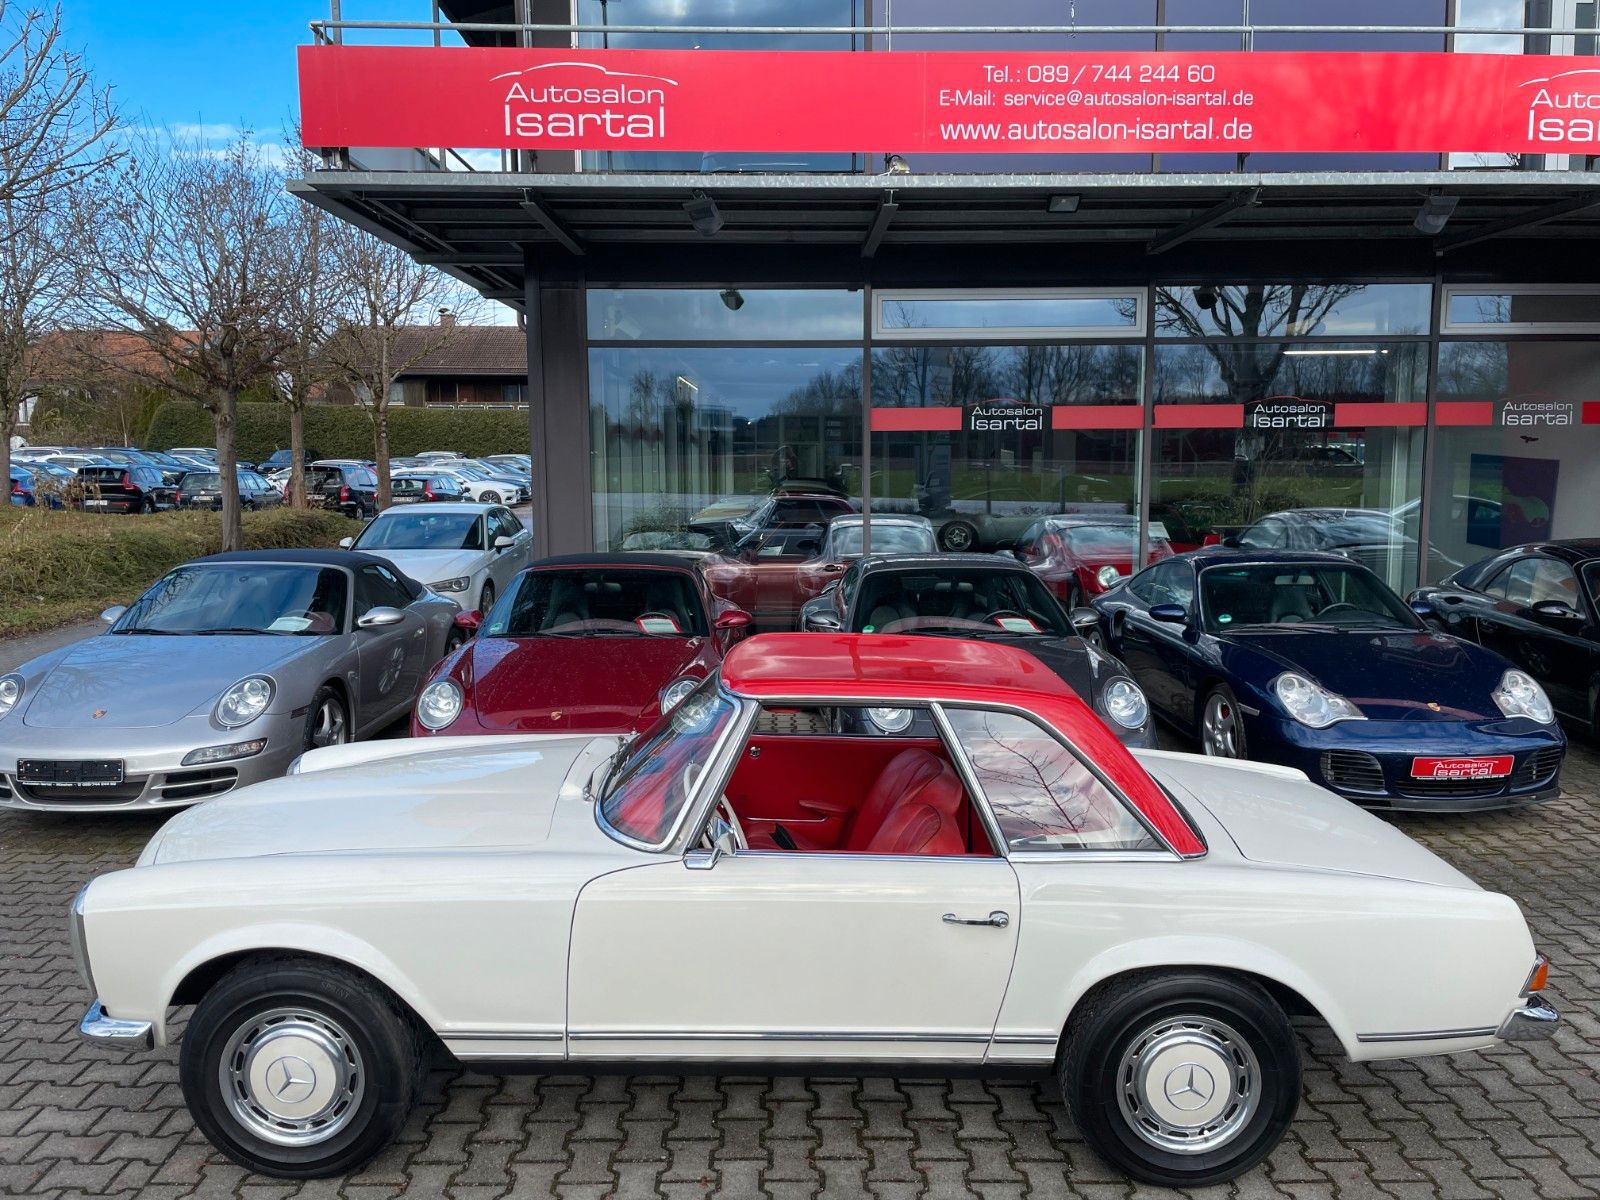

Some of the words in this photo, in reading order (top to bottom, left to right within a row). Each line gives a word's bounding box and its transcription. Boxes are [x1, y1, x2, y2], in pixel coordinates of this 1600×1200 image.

[983, 65, 1021, 83] Tel.:
[1027, 65, 1069, 83] 089
[1091, 65, 1132, 83] 744
[1139, 65, 1180, 83] 244
[1187, 65, 1215, 83] 60
[505, 82, 665, 105] Autosalon
[939, 90, 996, 106] E-Mail:
[1003, 89, 1254, 106] service@autosalon-isartal.de
[504, 104, 665, 138] Isartal
[940, 117, 1253, 140] www.autosalon-isartal.de
[1527, 109, 1600, 142] Isa
[971, 406, 1043, 416] Autosalon
[1254, 403, 1326, 413] Autosalon
[1503, 401, 1574, 411] Autosalon
[971, 415, 1043, 430] Isartal
[1253, 413, 1326, 428] Isartal
[1502, 410, 1573, 425] Isartal
[1433, 765, 1494, 776] Isartal
